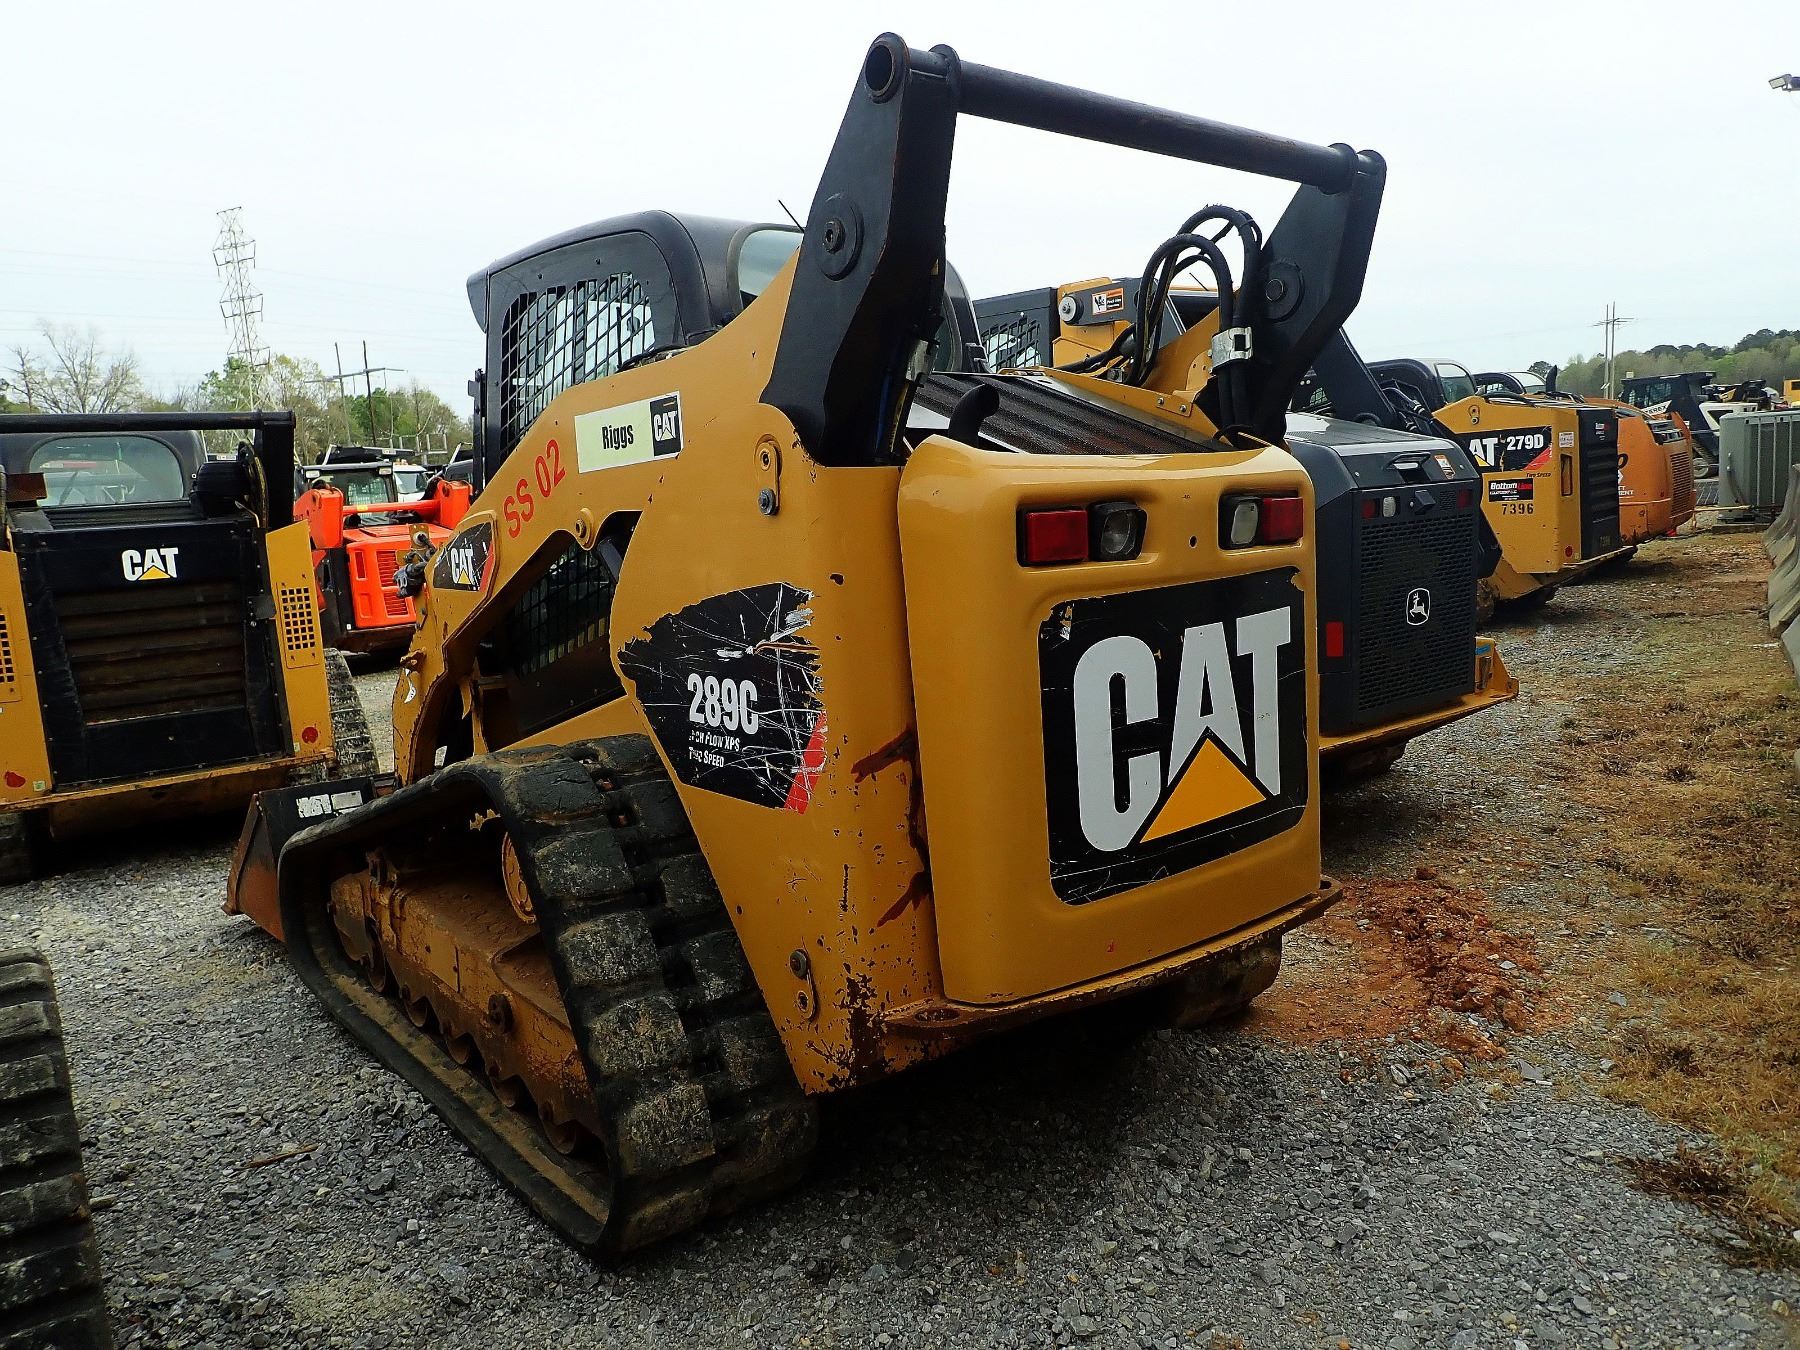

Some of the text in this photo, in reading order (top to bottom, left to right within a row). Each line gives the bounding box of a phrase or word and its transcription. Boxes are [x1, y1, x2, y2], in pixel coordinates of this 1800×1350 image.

[601, 423, 635, 450] Riggs
[653, 411, 677, 442] CAT
[1468, 437, 1499, 467] AT
[1506, 434, 1544, 451] 279D
[503, 438, 567, 539] SS 02
[1490, 482, 1518, 490] Bottom
[1501, 503, 1534, 515] 7396
[121, 547, 180, 582] CAT
[450, 547, 475, 585] CAT
[687, 673, 759, 735] 289C
[705, 731, 724, 748] FLOW
[724, 735, 741, 752] XPS
[1073, 606, 1291, 852] CAT
[703, 750, 725, 768] SPEED
